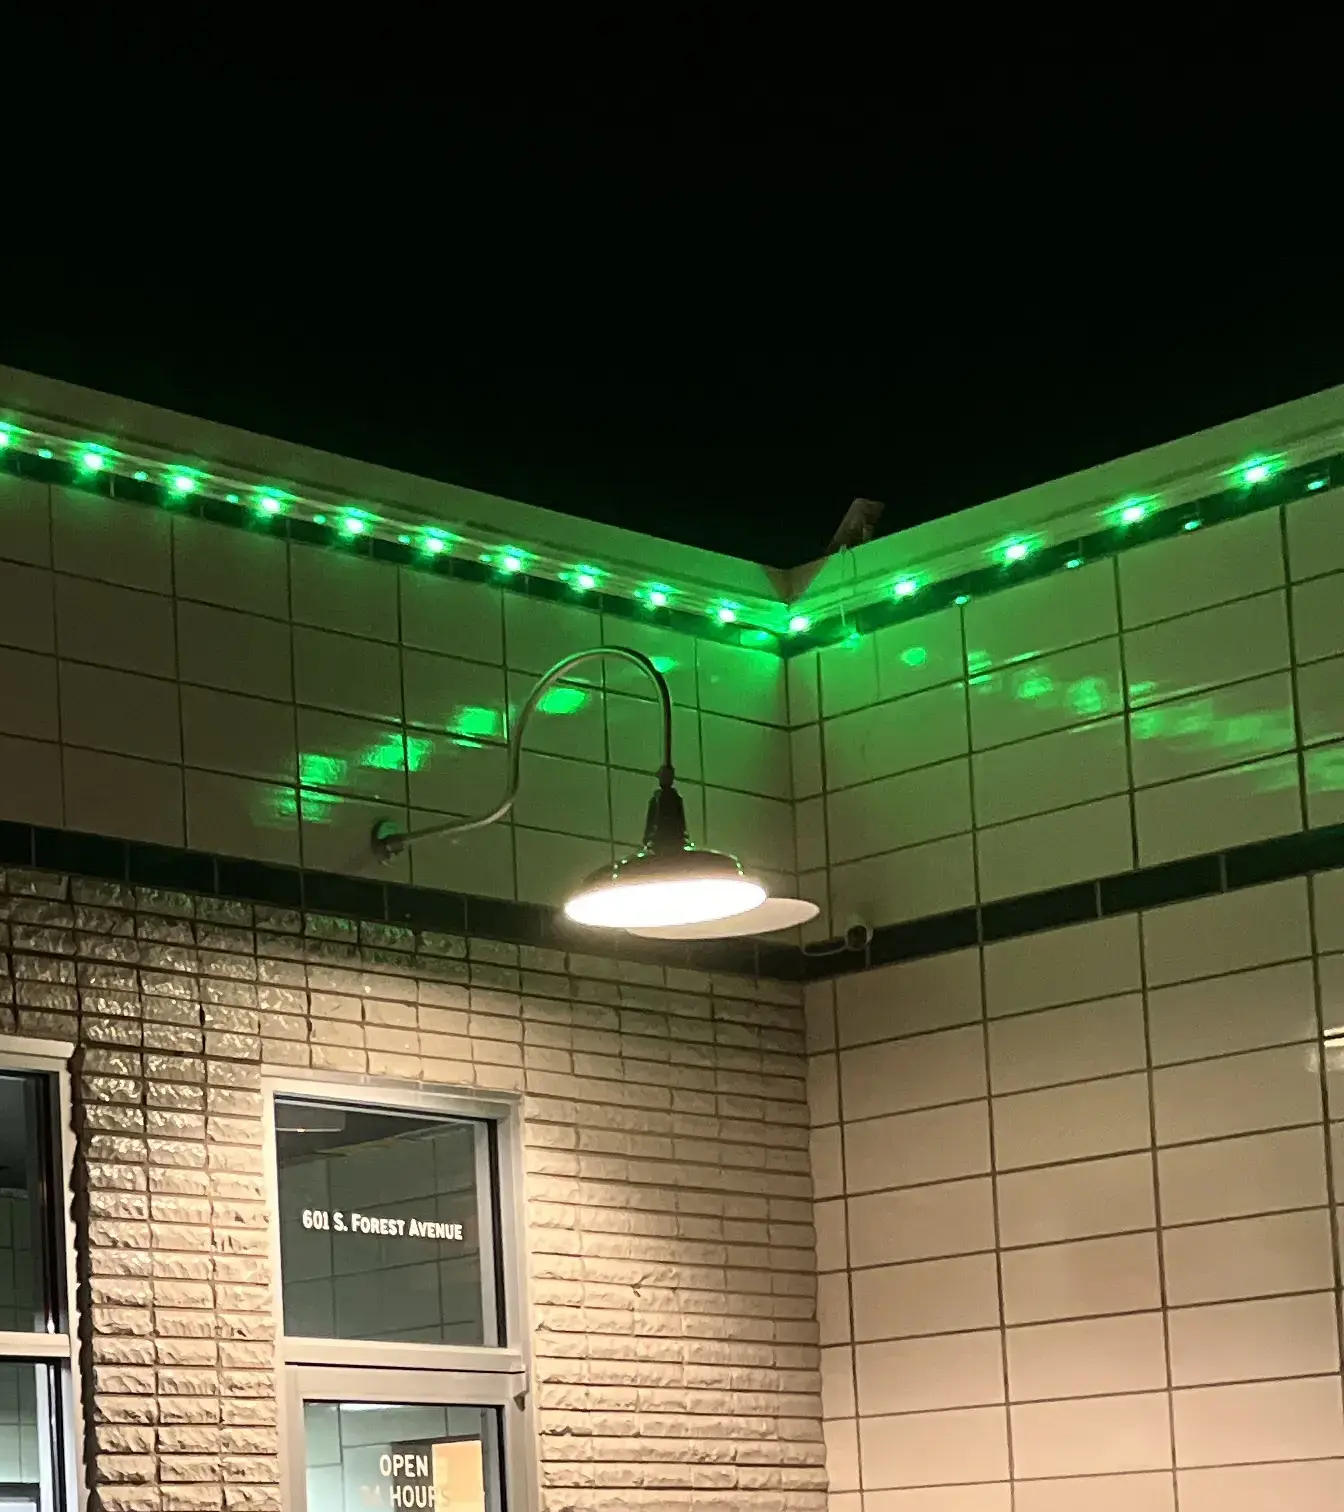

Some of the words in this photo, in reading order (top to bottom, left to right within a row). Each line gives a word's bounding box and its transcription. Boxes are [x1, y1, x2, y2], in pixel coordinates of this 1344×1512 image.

[302, 1209, 330, 1230] 601
[333, 1210, 348, 1232] S.
[351, 1213, 406, 1236] FOREST
[409, 1218, 463, 1241] AVENUE
[379, 1454, 429, 1478] OPEN
[389, 1485, 451, 1508] HOURS
